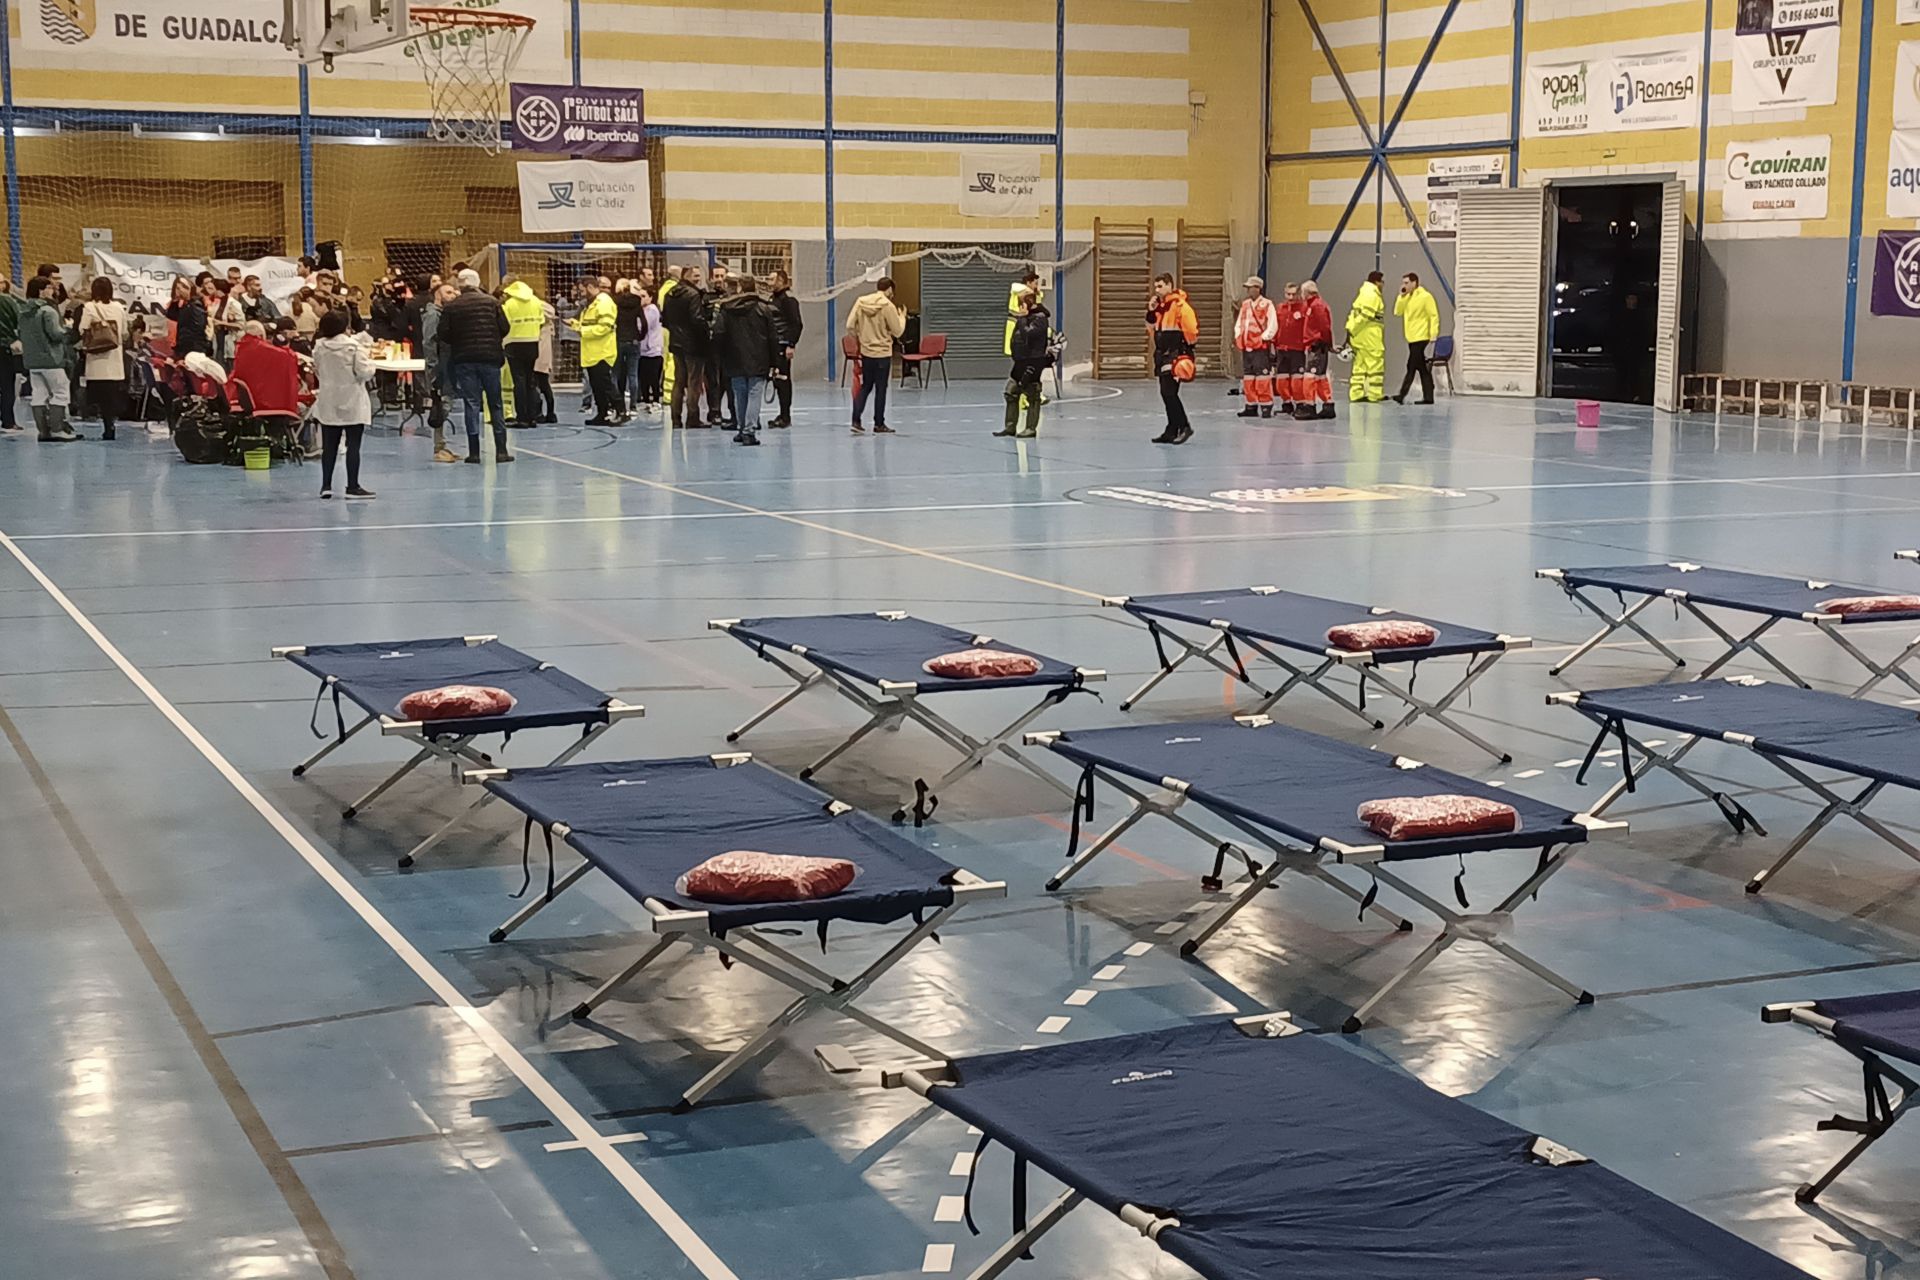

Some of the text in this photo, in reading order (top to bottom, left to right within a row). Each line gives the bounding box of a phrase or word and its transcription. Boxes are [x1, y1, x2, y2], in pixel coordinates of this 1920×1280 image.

[114, 13, 284, 43] DE GUADALC
[1753, 59, 1776, 69] GRUPO
[1543, 74, 1579, 95] PODA
[576, 97, 638, 107] DIVISIÓN
[614, 106, 639, 123] SALA
[587, 129, 639, 143] Iberdrola
[578, 181, 635, 193] Diputación
[1764, 178, 1794, 189] PACHECO
[1795, 177, 1826, 188] COLLADO
[580, 196, 592, 208] de
